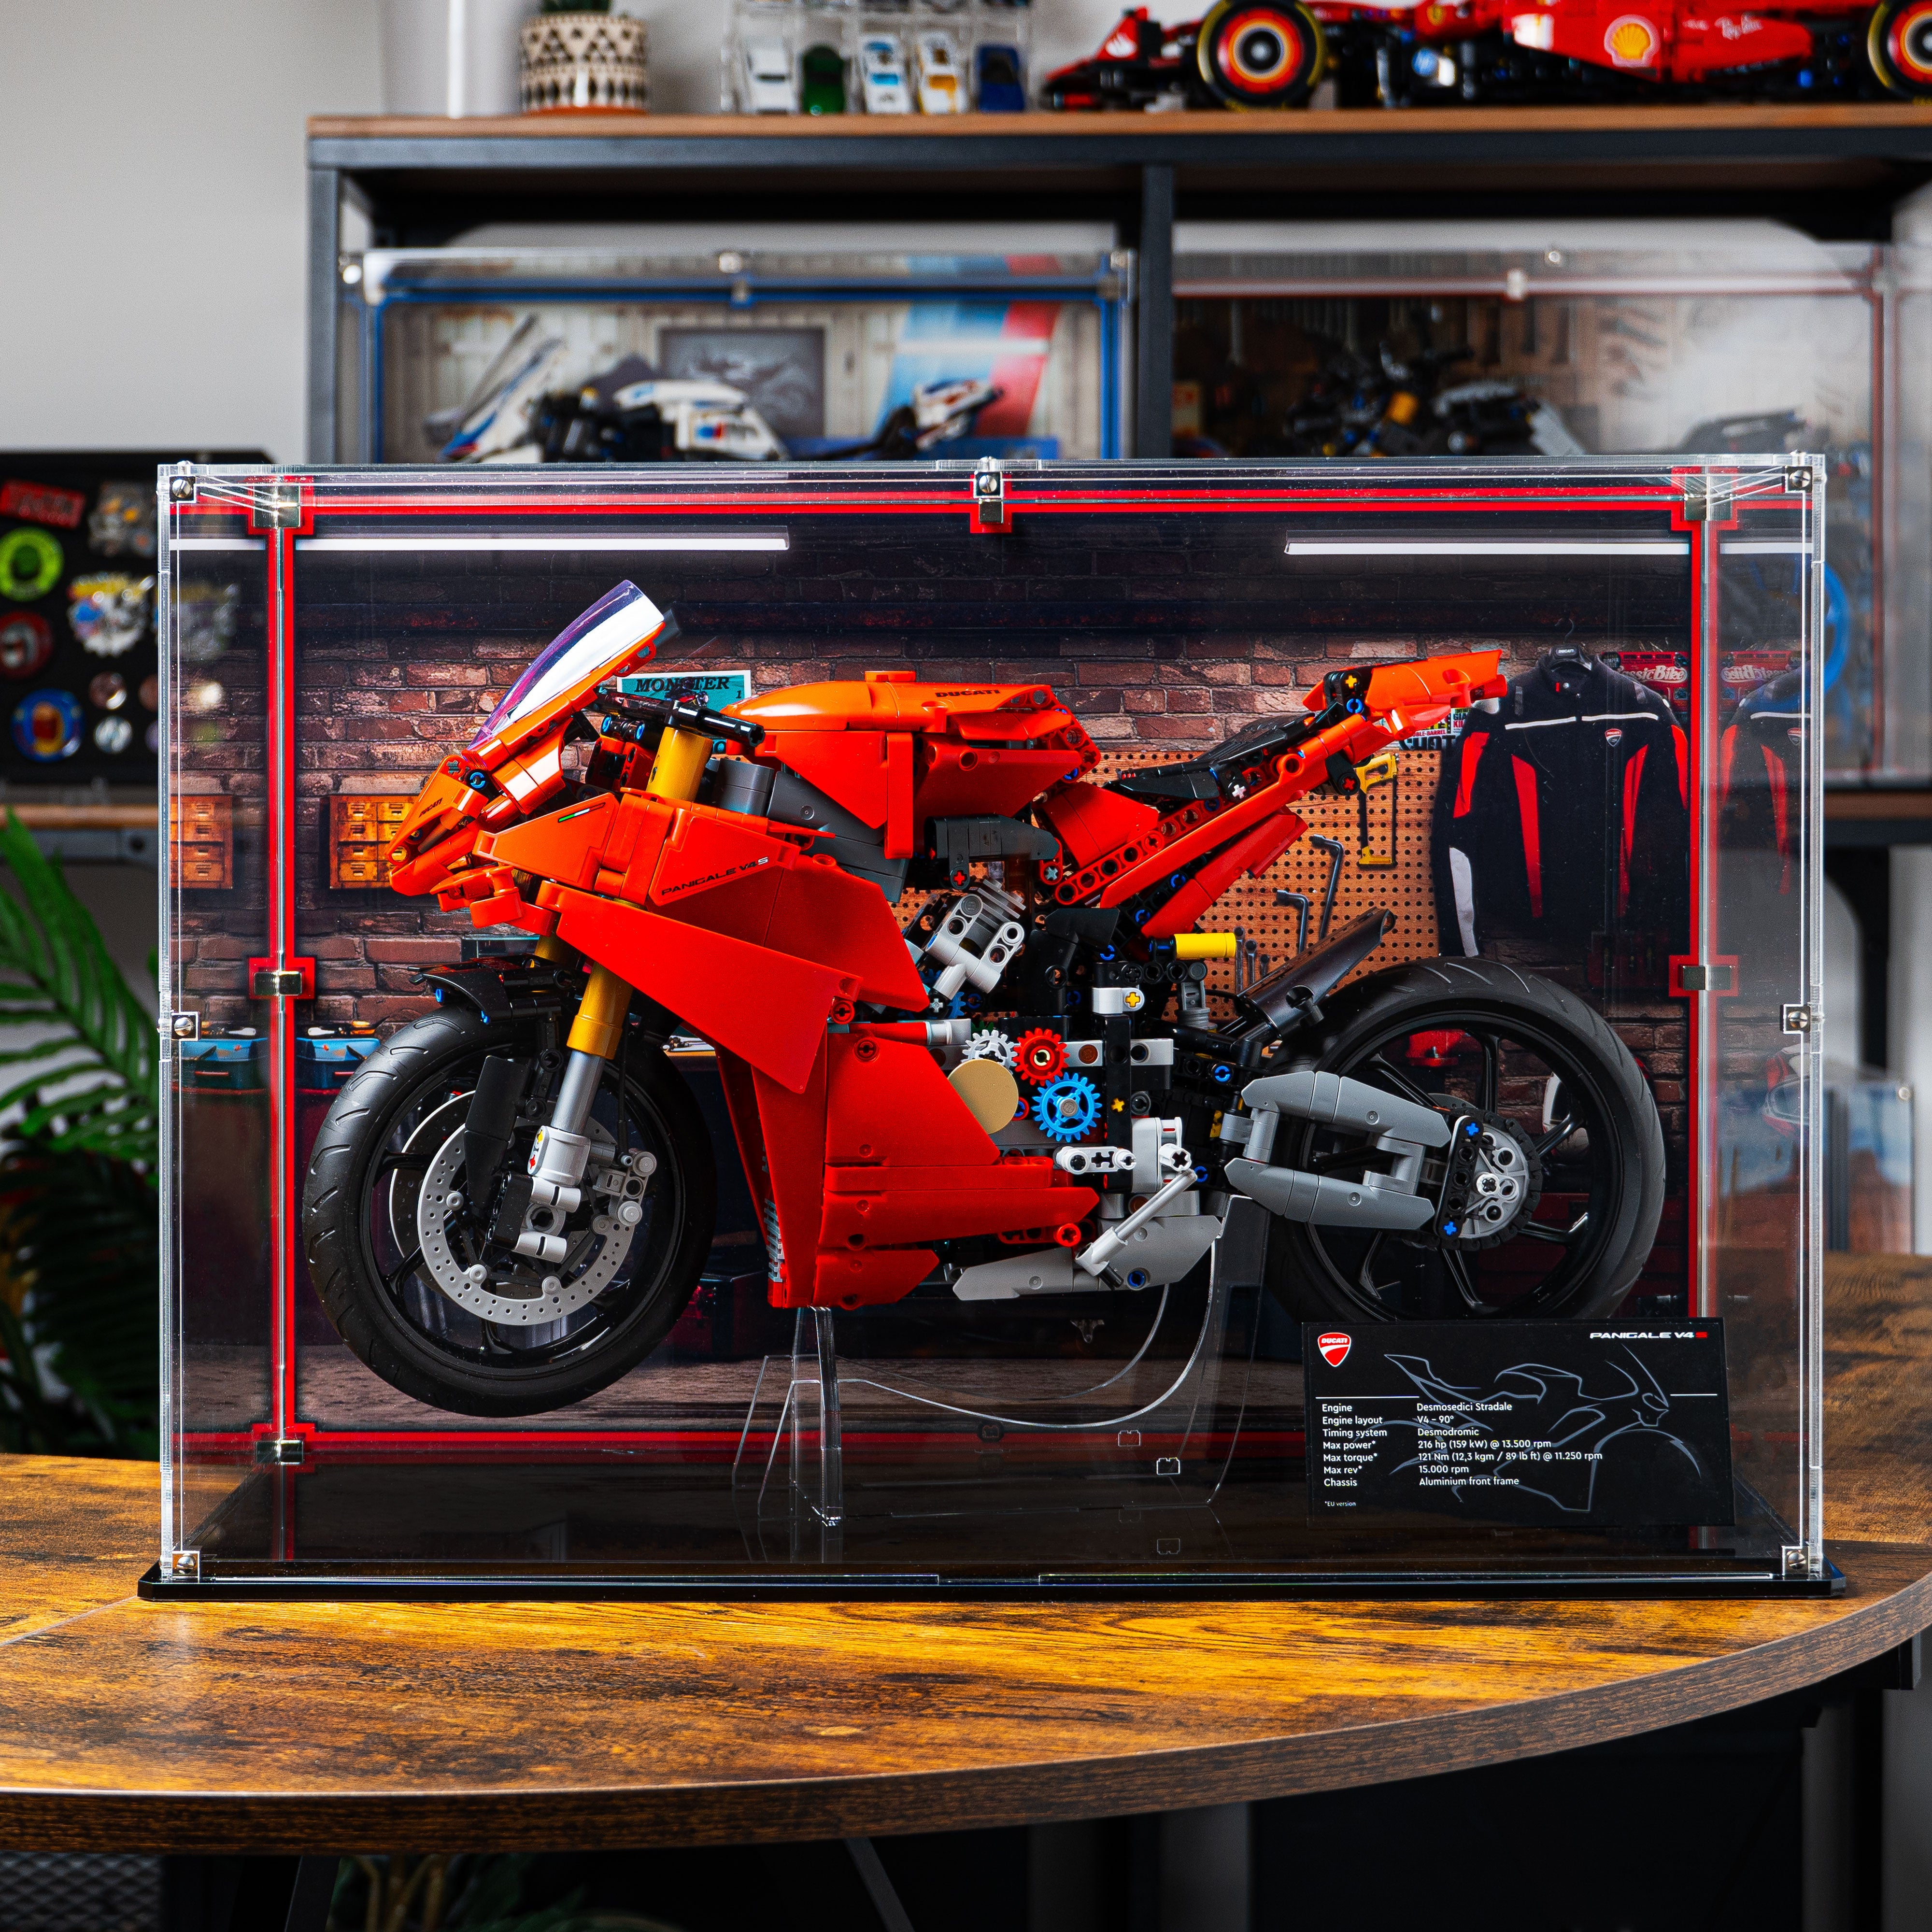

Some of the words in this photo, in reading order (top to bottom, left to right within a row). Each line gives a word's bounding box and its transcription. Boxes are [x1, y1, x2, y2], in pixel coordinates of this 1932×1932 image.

[634, 677, 729, 692] MONTER
[736, 690, 741, 698] 1
[419, 797, 443, 818] DUCATI
[662, 867, 736, 895] PANIGALE
[1322, 1403, 1352, 1413] Engine
[1417, 1402, 1473, 1411] Desmosedici
[1476, 1402, 1512, 1411] Stradale
[1322, 1416, 1352, 1426] Engine
[1355, 1415, 1383, 1426] layout
[1439, 1415, 1454, 1423] 90°
[1322, 1428, 1353, 1438] Timing
[1356, 1429, 1387, 1438] system
[1418, 1427, 1479, 1436] Desmodromic
[1418, 1440, 1433, 1449] 216
[1435, 1439, 1447, 1449] hp
[1449, 1440, 1467, 1449] (159
[1469, 1439, 1488, 1449] kW)
[1490, 1440, 1500, 1449] @
[1452, 1452, 1472, 1462] (12,3
[1475, 1452, 1494, 1462] kgm
[1497, 1451, 1503, 1461] /
[1519, 1451, 1528, 1460] lb
[1530, 1452, 1540, 1461] ft)
[1543, 1452, 1552, 1461] @
[1584, 1453, 1603, 1461] rpm
[1451, 1466, 1469, 1475] rpm
[1324, 1478, 1358, 1486] Chassis
[1419, 1477, 1466, 1485] Aluminium
[1469, 1477, 1491, 1485] front
[1493, 1476, 1520, 1485] frame
